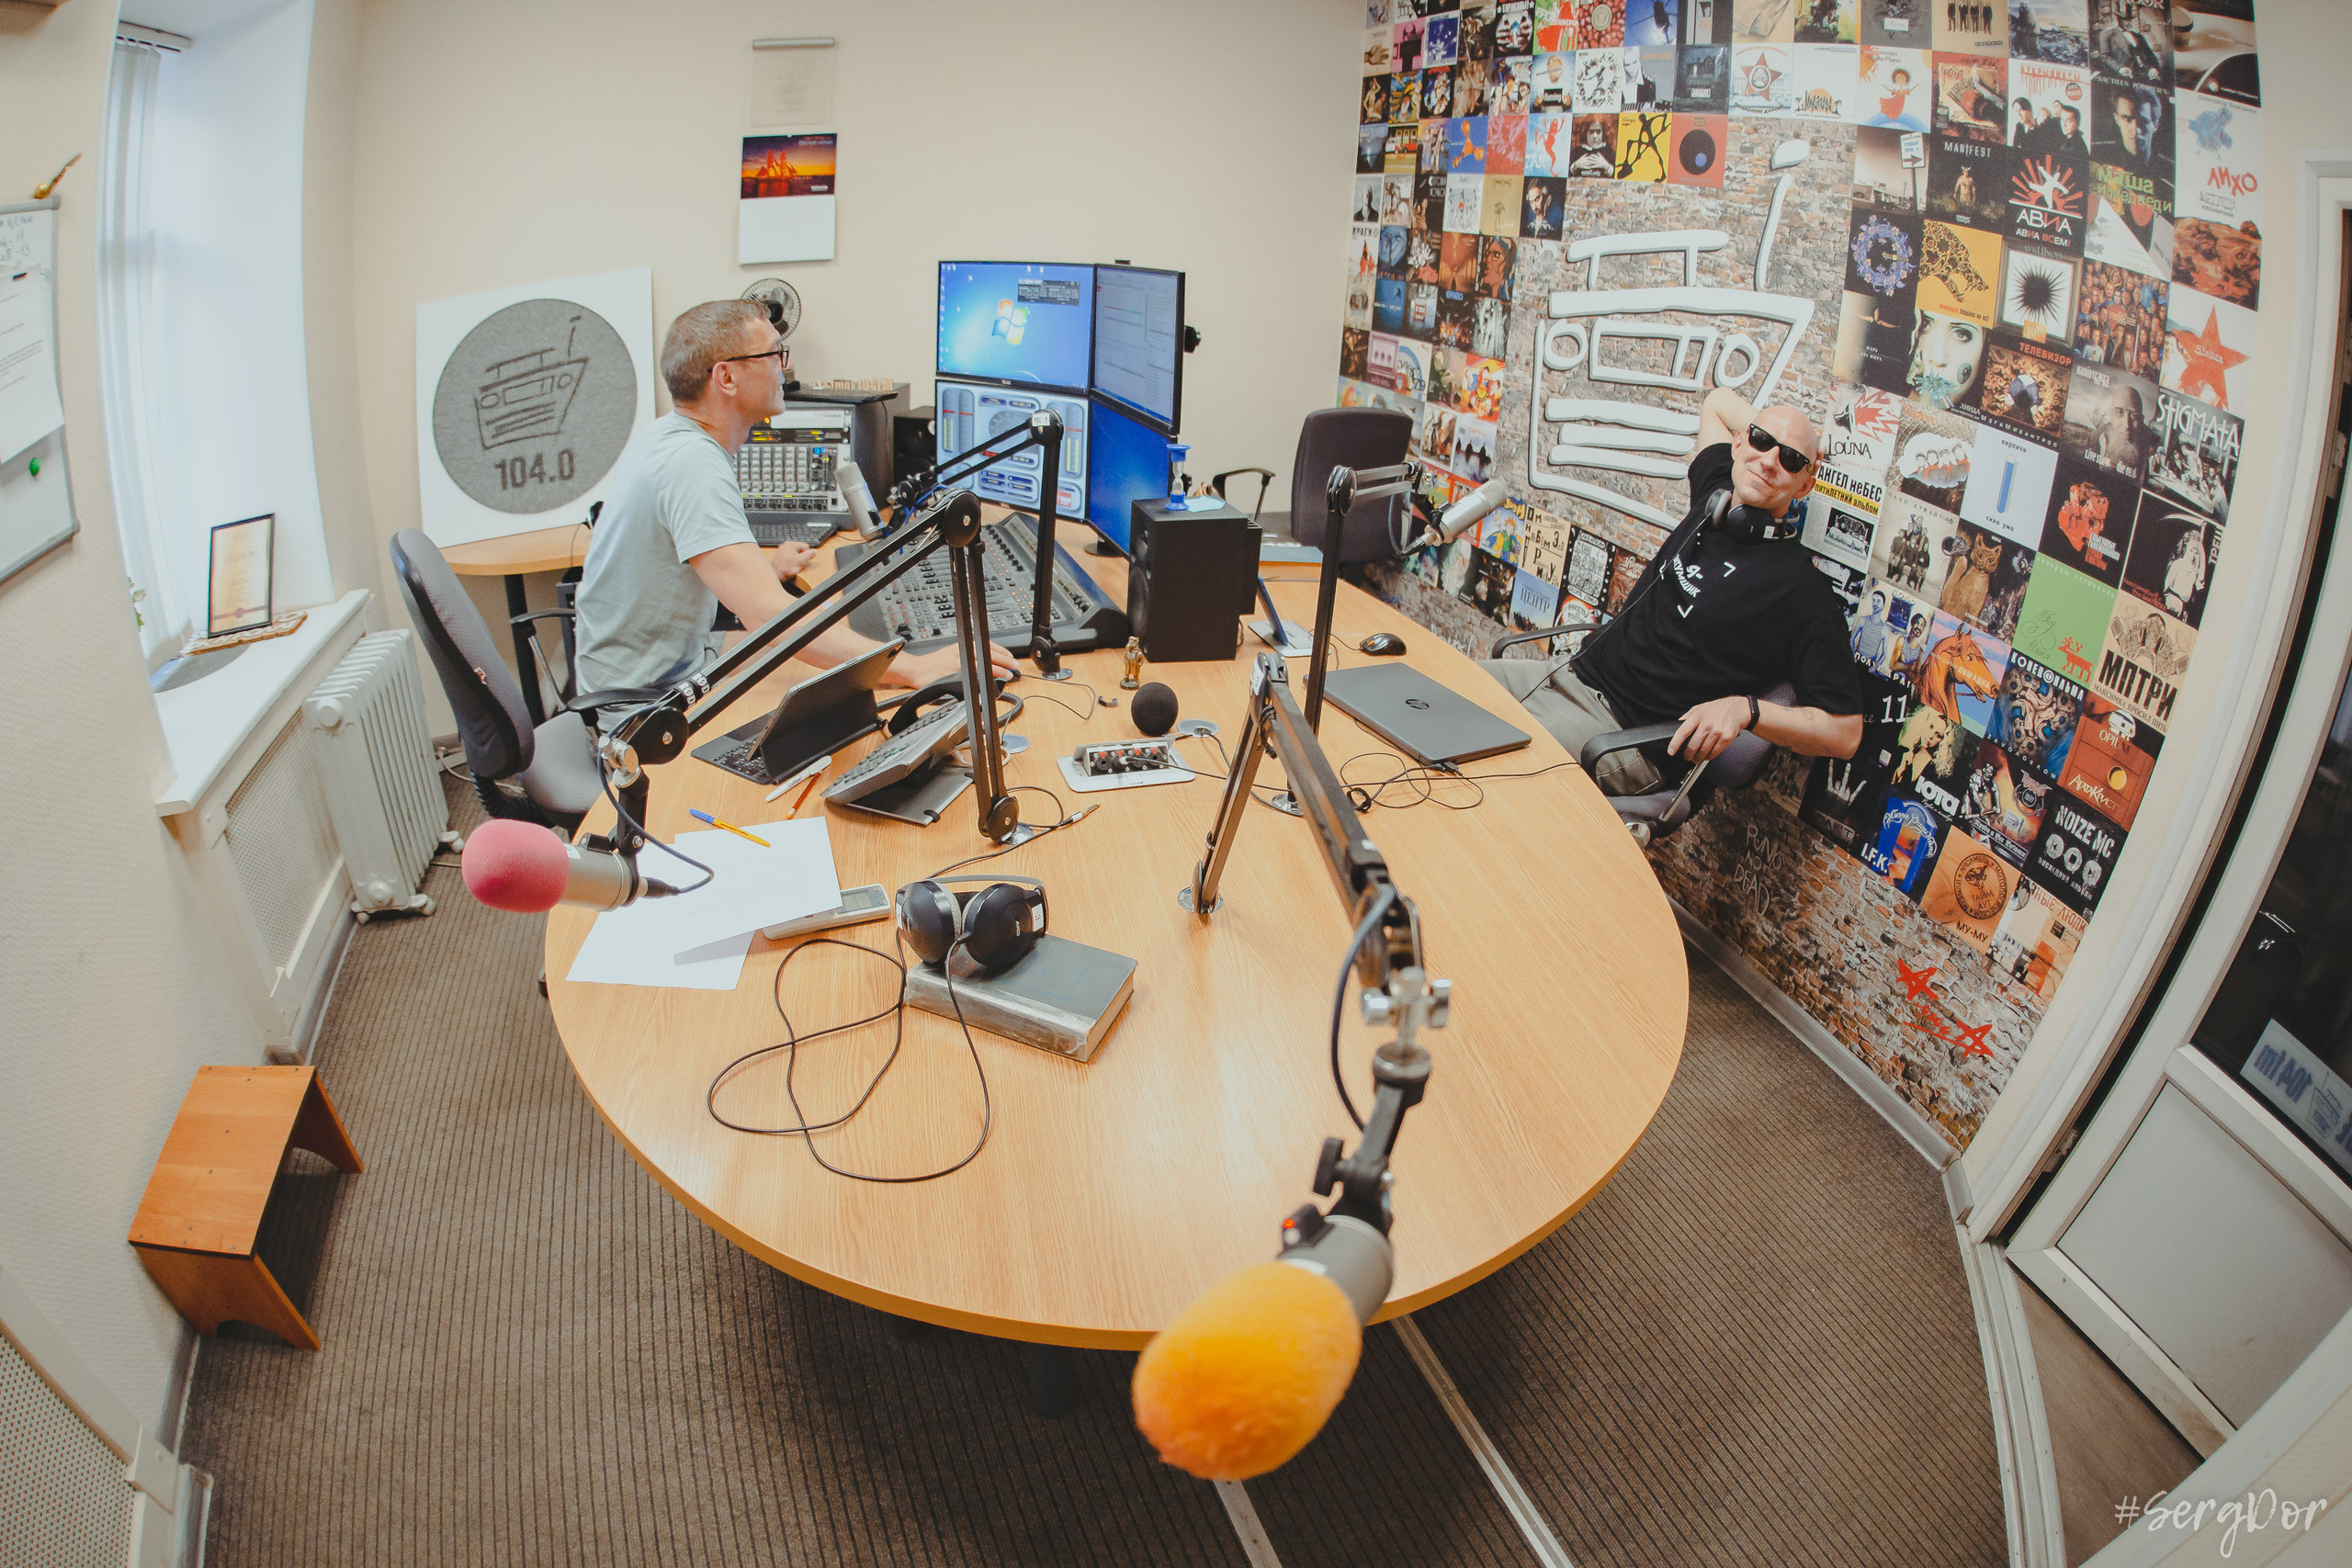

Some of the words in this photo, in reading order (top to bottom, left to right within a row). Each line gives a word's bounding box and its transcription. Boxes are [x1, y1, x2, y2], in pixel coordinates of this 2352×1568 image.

[1944, 141, 1992, 159] MANIFEST
[2017, 209, 2073, 236] АВИА
[2016, 228, 2041, 242] АВИА
[2041, 232, 2073, 249] ВСЕМ!
[2019, 342, 2072, 367] ТЕЛЕВИЗОР
[2156, 394, 2240, 457] STIGMATA
[493, 446, 576, 491] 104.0
[1816, 464, 1850, 491] АНГЕЛ
[1852, 497, 1880, 517] альбом
[1520, 587, 1551, 615] ЦЕНТР
[1881, 694, 1908, 724] 11
[2094, 683, 2127, 709] МАКСИМКА
[2098, 729, 2131, 755] OPIUM
[2054, 805, 2095, 846] NOIZE
[2091, 829, 2116, 859] MC
[1746, 825, 1786, 870] PUNKS
[1860, 843, 1889, 874] I.F.K.
[1734, 863, 1772, 918] DEAD
[1971, 889, 1994, 903] ТАЙМ
[1956, 920, 1989, 943] МУ-МУ
[2056, 905, 2087, 933] ЛЮДИ
